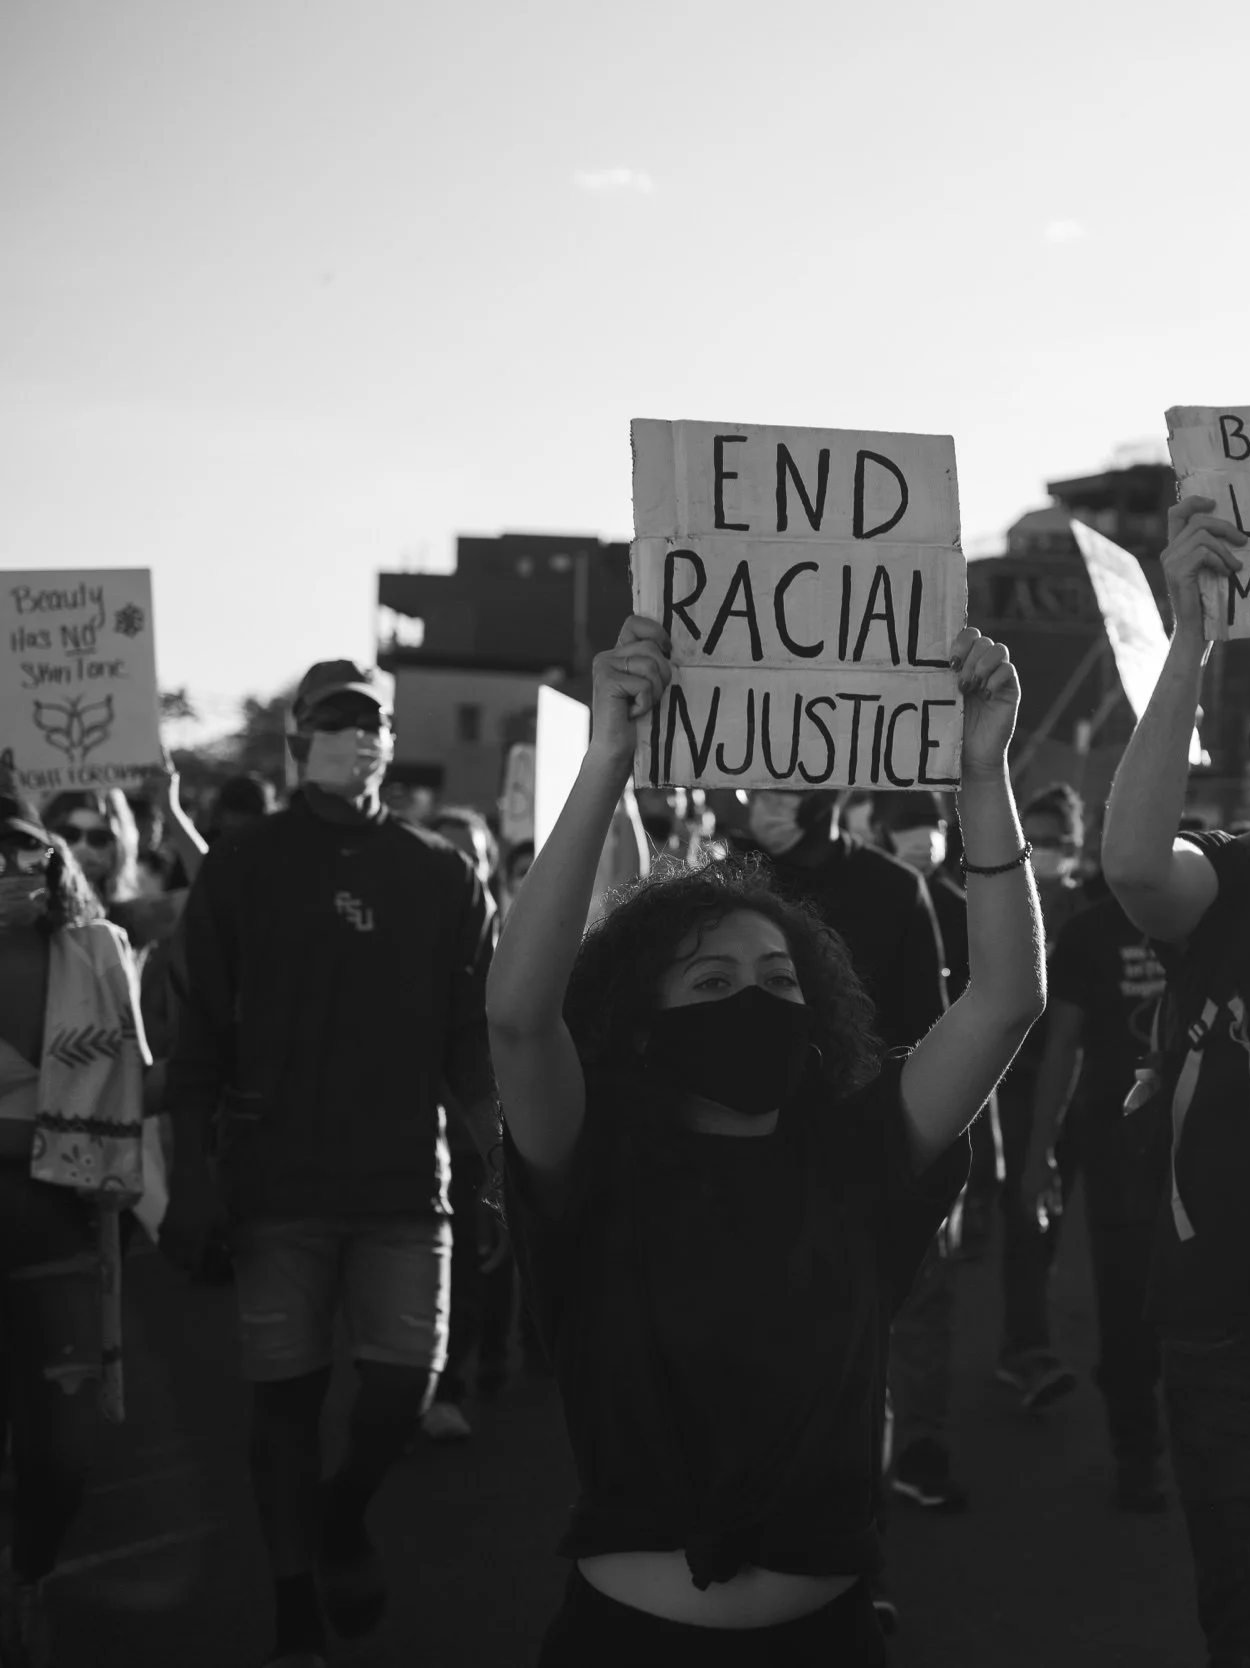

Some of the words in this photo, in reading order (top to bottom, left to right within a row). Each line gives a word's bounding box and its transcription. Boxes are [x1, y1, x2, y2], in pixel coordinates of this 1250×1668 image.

[713, 434, 909, 540] END
[10, 580, 107, 630] Beauty
[662, 549, 952, 668] RACIAL
[648, 683, 960, 787] INJUSTICE
[333, 889, 377, 932] FSU
